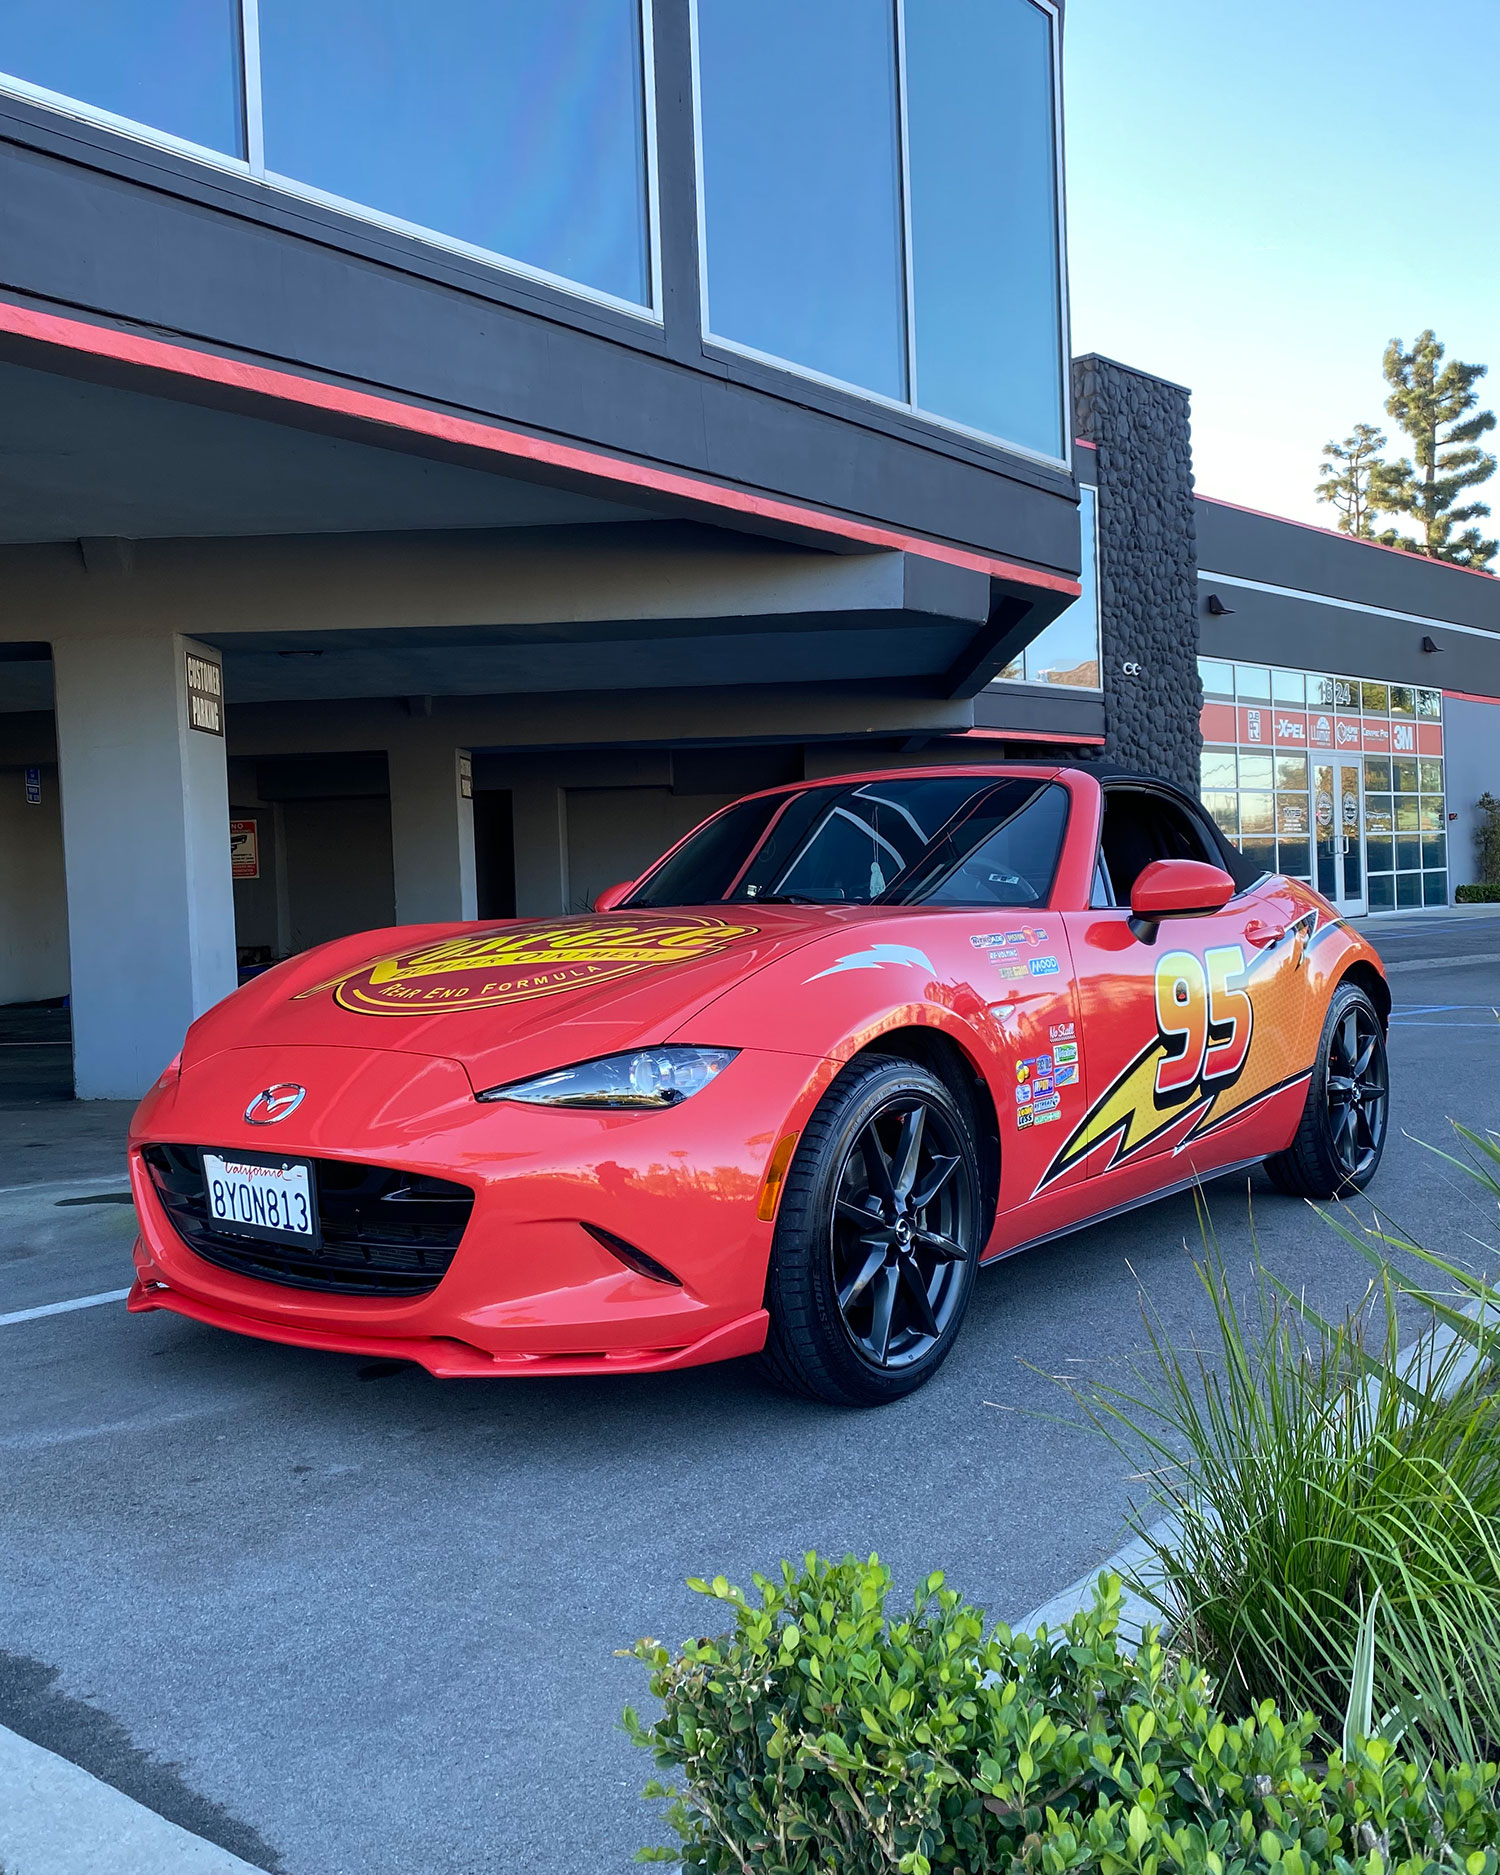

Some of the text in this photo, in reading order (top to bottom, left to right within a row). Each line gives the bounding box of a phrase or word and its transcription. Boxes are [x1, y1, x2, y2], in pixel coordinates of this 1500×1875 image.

[187, 656, 220, 696] CUSTOMER
[1319, 680, 1351, 705] 1624
[192, 695, 219, 731] PARKING
[1278, 718, 1306, 739] XPEL
[1393, 725, 1413, 750] 3M
[391, 951, 666, 981] BUMPER OINTMENT
[1032, 957, 1057, 973] MOOD
[378, 965, 602, 999] REAR END FORMULA
[1153, 945, 1254, 1102] 95
[225, 1162, 293, 1182] California
[213, 1179, 308, 1232] 8YON813
